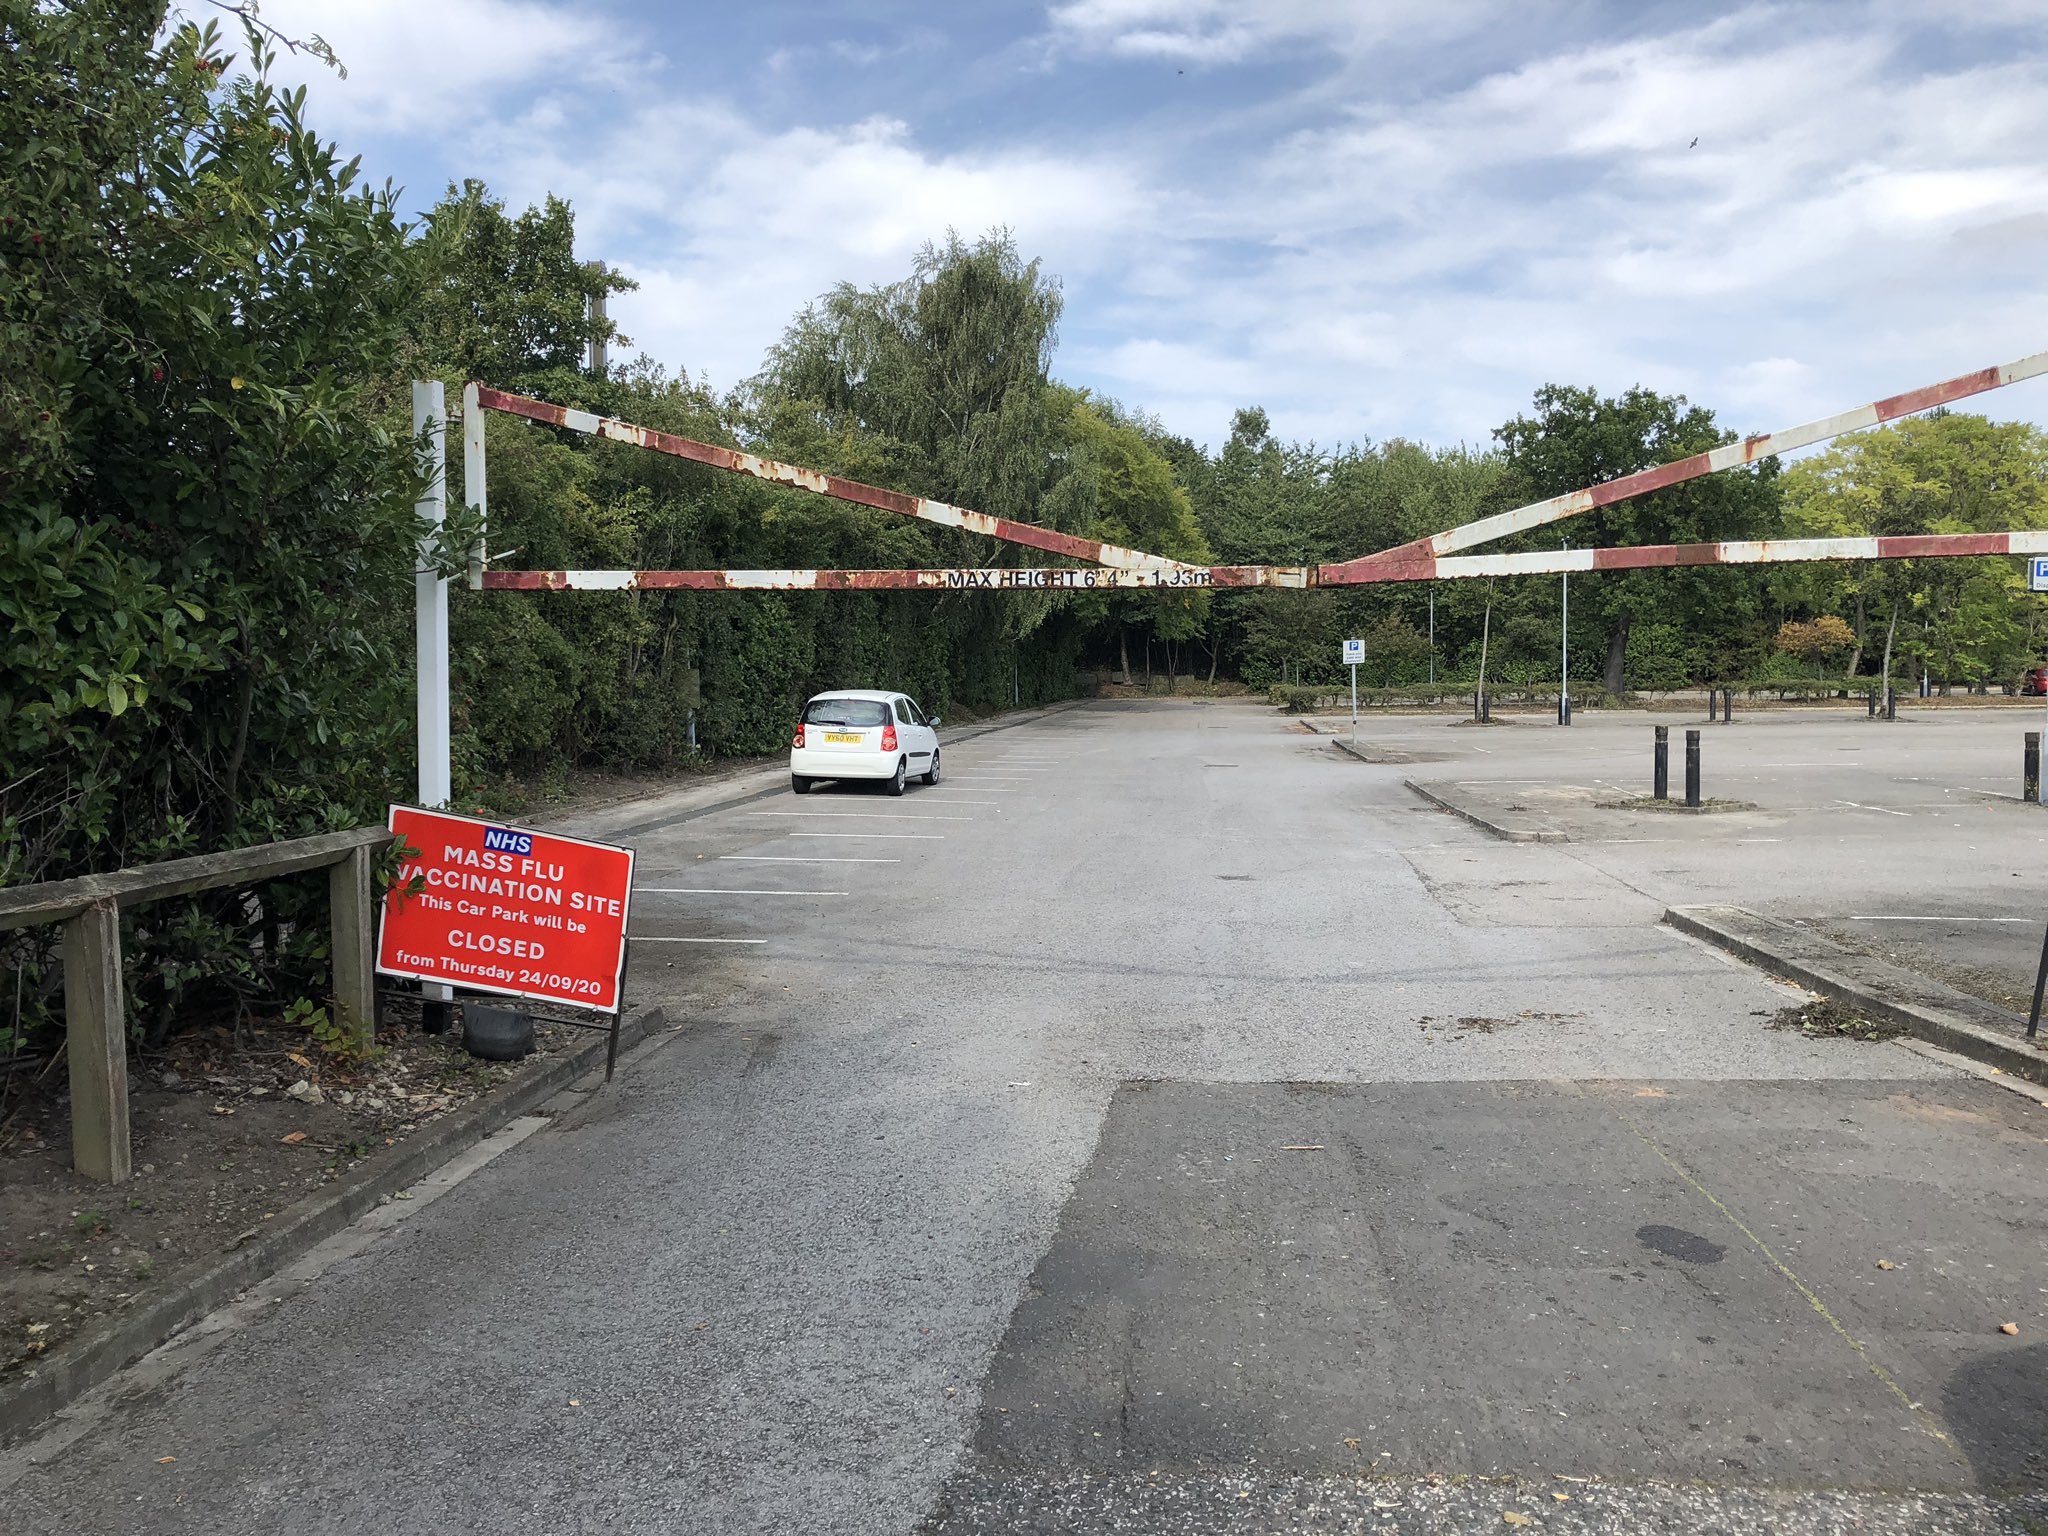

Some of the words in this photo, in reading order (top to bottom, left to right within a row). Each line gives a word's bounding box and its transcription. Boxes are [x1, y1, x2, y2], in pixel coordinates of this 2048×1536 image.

[947, 571, 993, 587] MAX
[1000, 571, 1078, 587] HEIGHT
[485, 831, 532, 853] NHS
[444, 845, 514, 873] MASS
[521, 859, 564, 882] FLU
[418, 893, 453, 912] This
[456, 899, 487, 917] Car
[492, 905, 529, 924] Park
[533, 915, 563, 933] will
[566, 917, 588, 934] be
[569, 891, 621, 917] SITE
[447, 929, 545, 960] CLOSED
[396, 950, 435, 968] from
[440, 956, 515, 984] Thursday
[518, 969, 602, 996] 24/09/20
